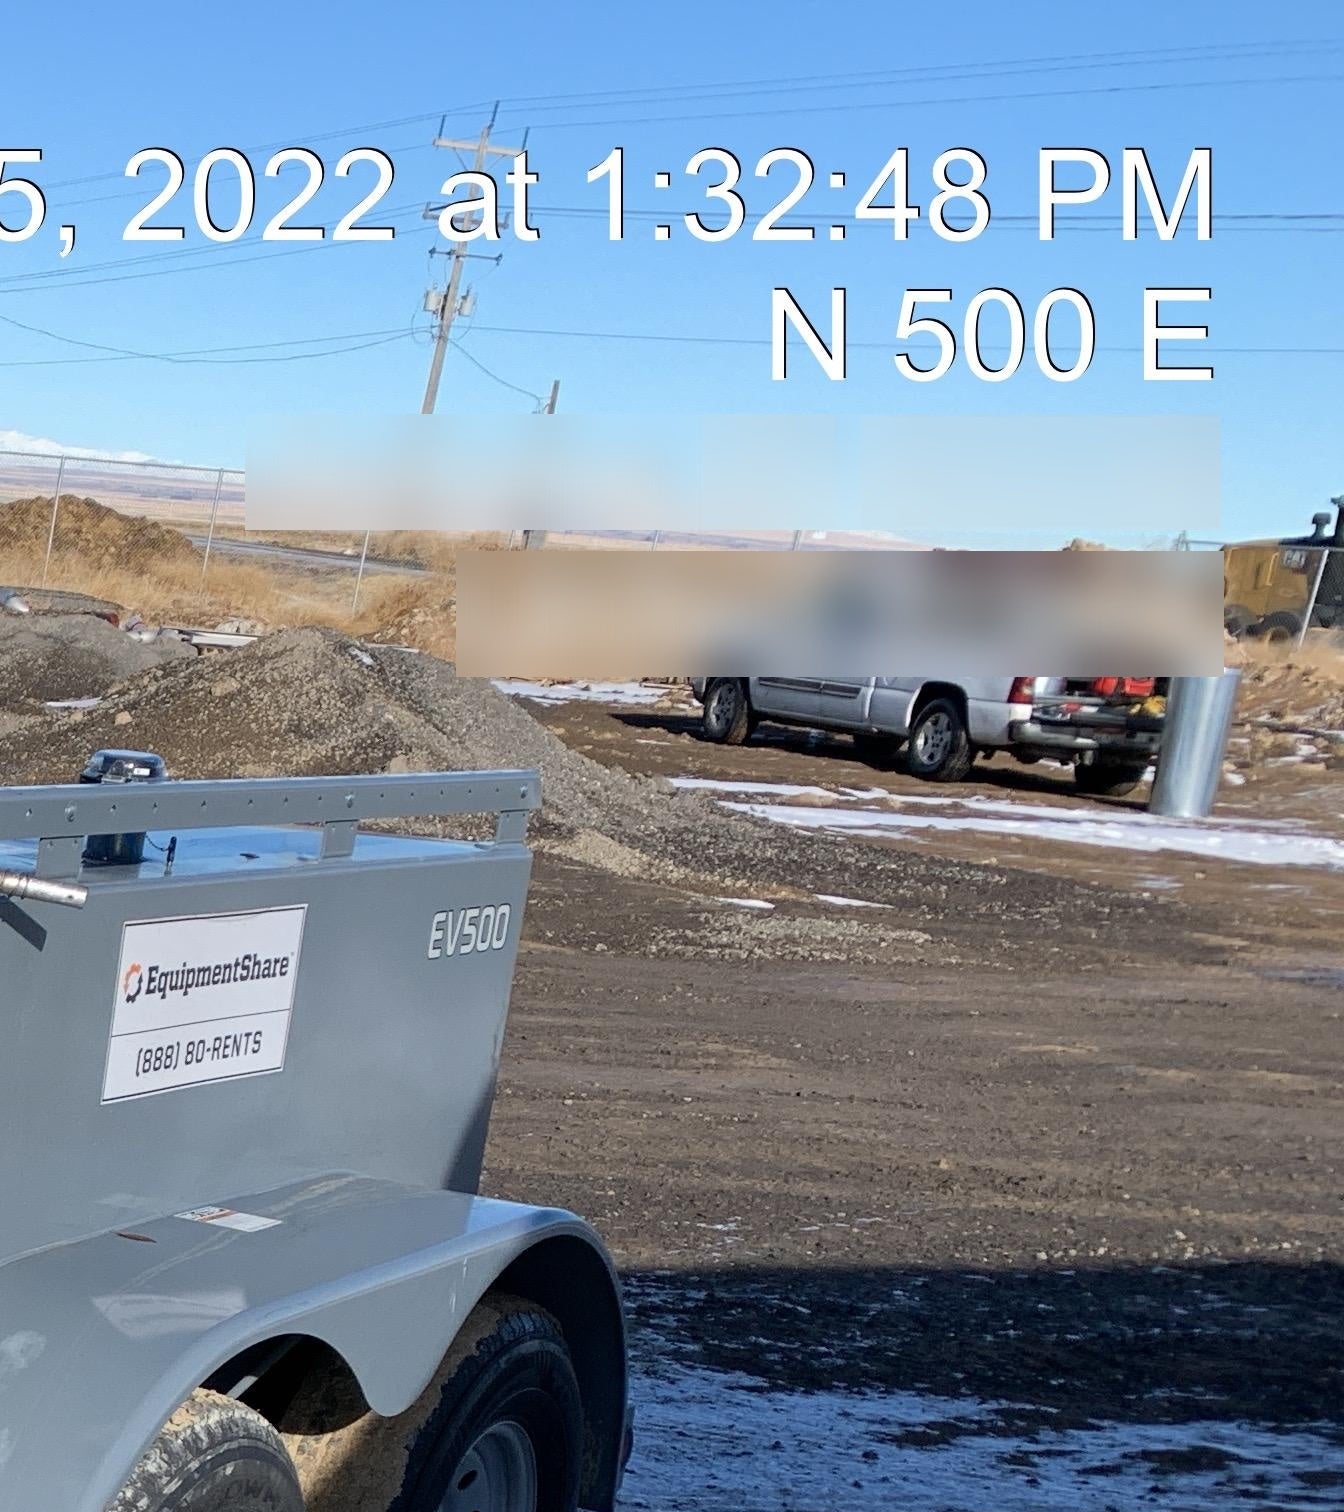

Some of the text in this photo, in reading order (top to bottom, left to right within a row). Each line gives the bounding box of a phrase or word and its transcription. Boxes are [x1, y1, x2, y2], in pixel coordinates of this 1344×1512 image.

[1282, 549, 1307, 569] CAT
[427, 902, 512, 960] EV500
[145, 952, 290, 1000] EquipmentShare
[135, 1030, 263, 1077] (888) 80-RENTS
